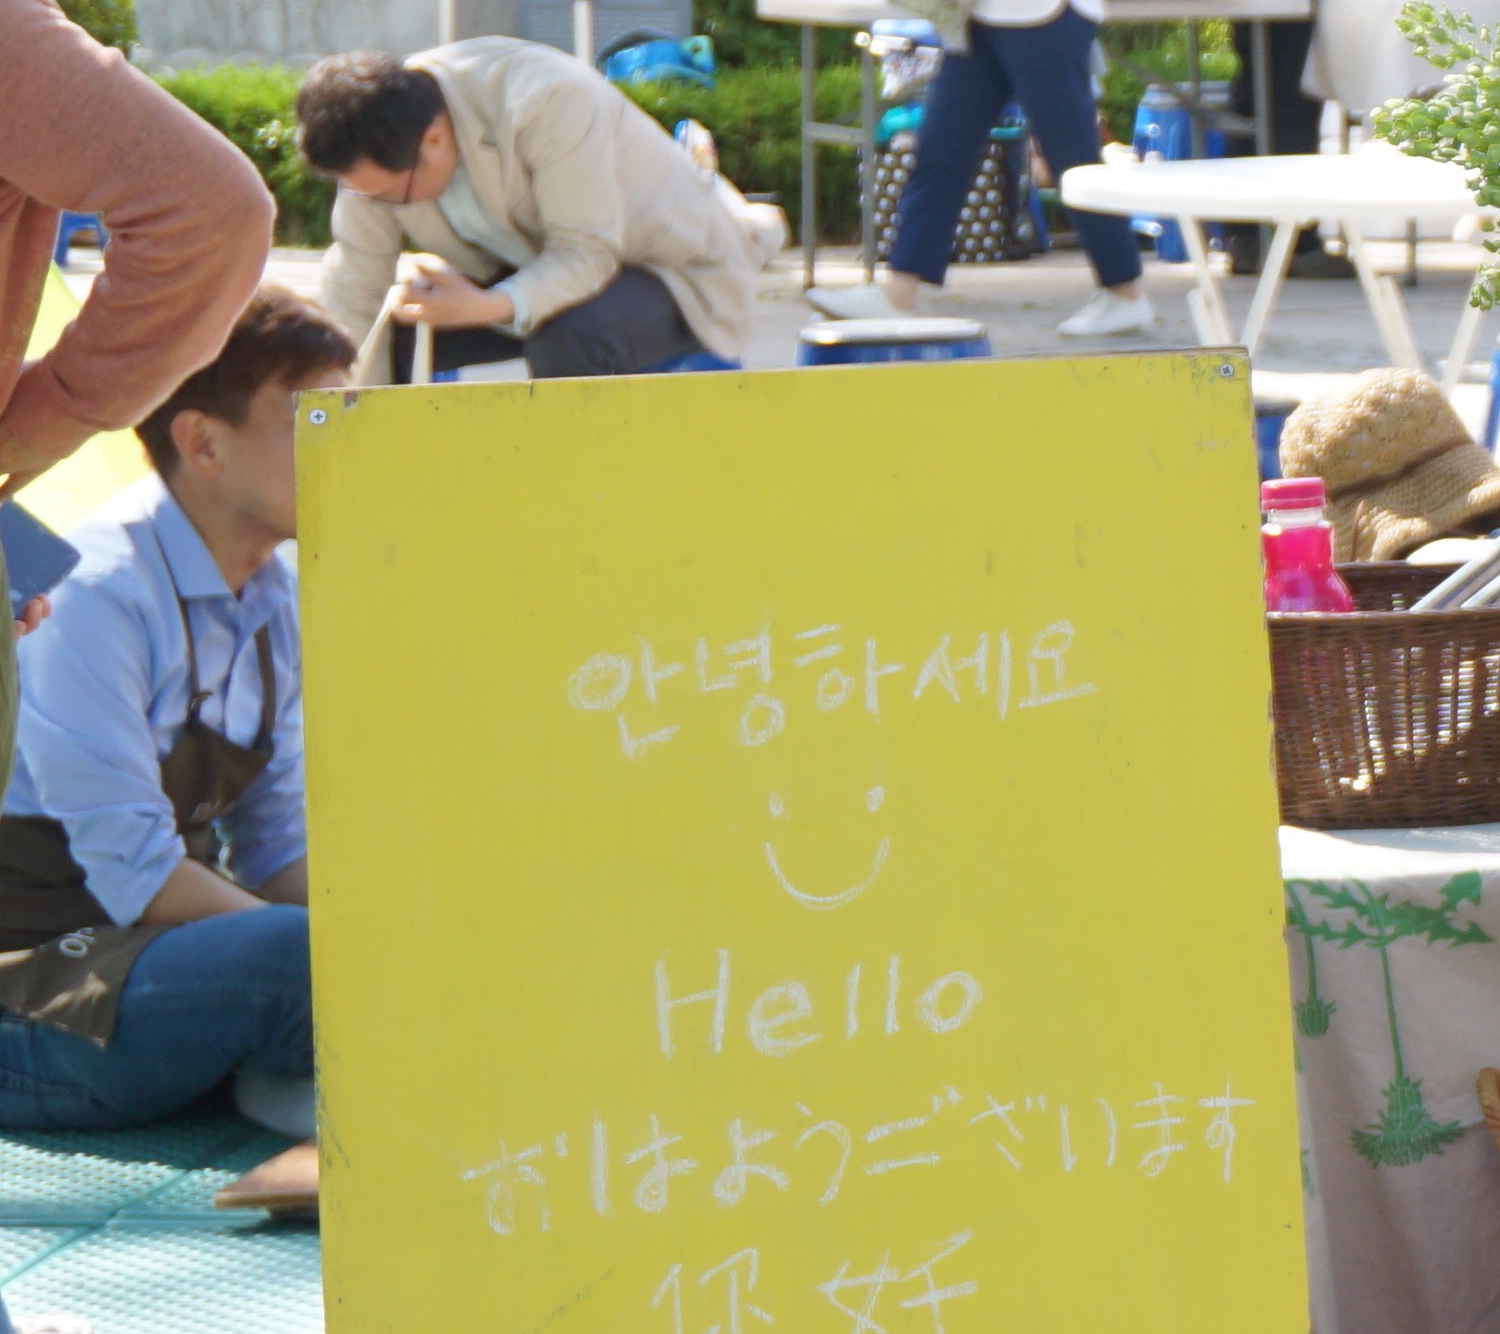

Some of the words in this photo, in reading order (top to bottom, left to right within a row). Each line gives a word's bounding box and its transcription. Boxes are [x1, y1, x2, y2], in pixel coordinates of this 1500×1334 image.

[568, 620, 1099, 759] 안녕하세요
[655, 949, 983, 1058] Hello
[461, 1074, 1257, 1236] おはようございます
